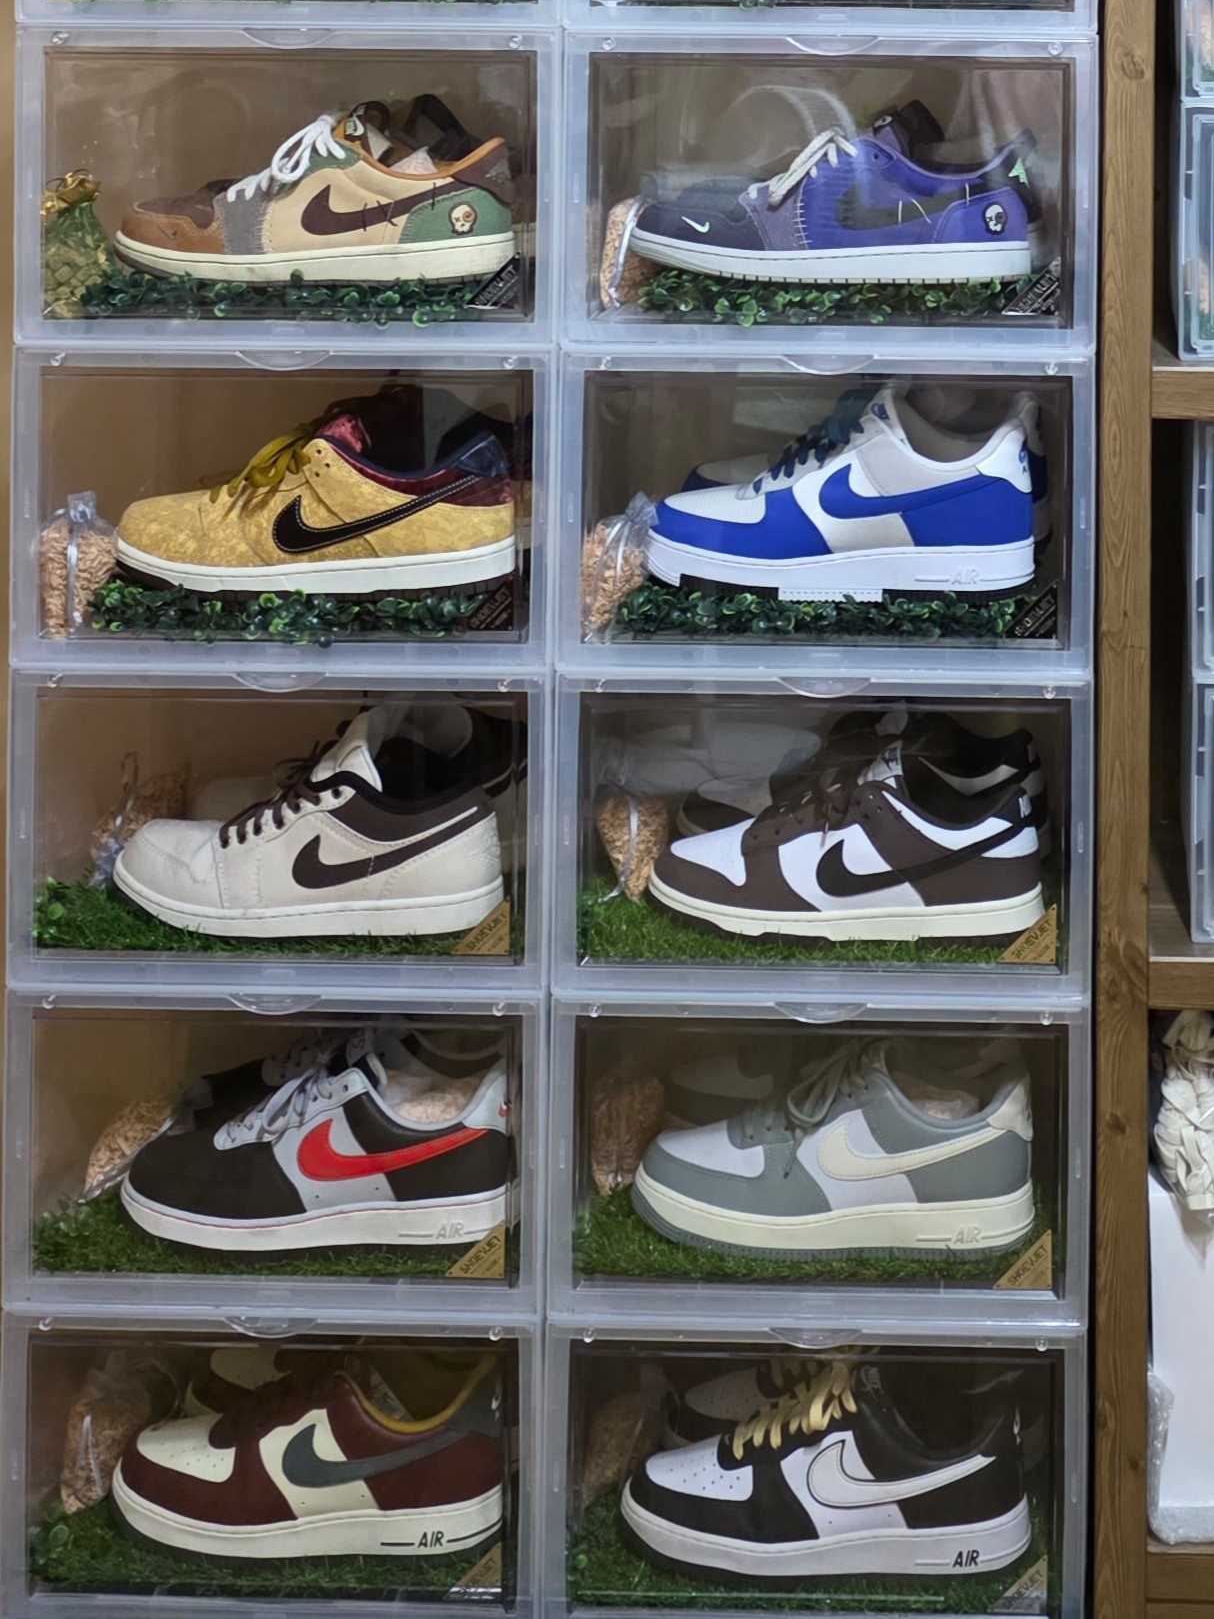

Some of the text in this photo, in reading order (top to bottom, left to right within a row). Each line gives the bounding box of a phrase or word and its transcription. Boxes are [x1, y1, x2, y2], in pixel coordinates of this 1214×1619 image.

[951, 569, 979, 585] AIR
[435, 1223, 464, 1239] AIR
[953, 1226, 981, 1245] AIR
[417, 1530, 444, 1549] AIR
[952, 1549, 979, 1568] AIR
